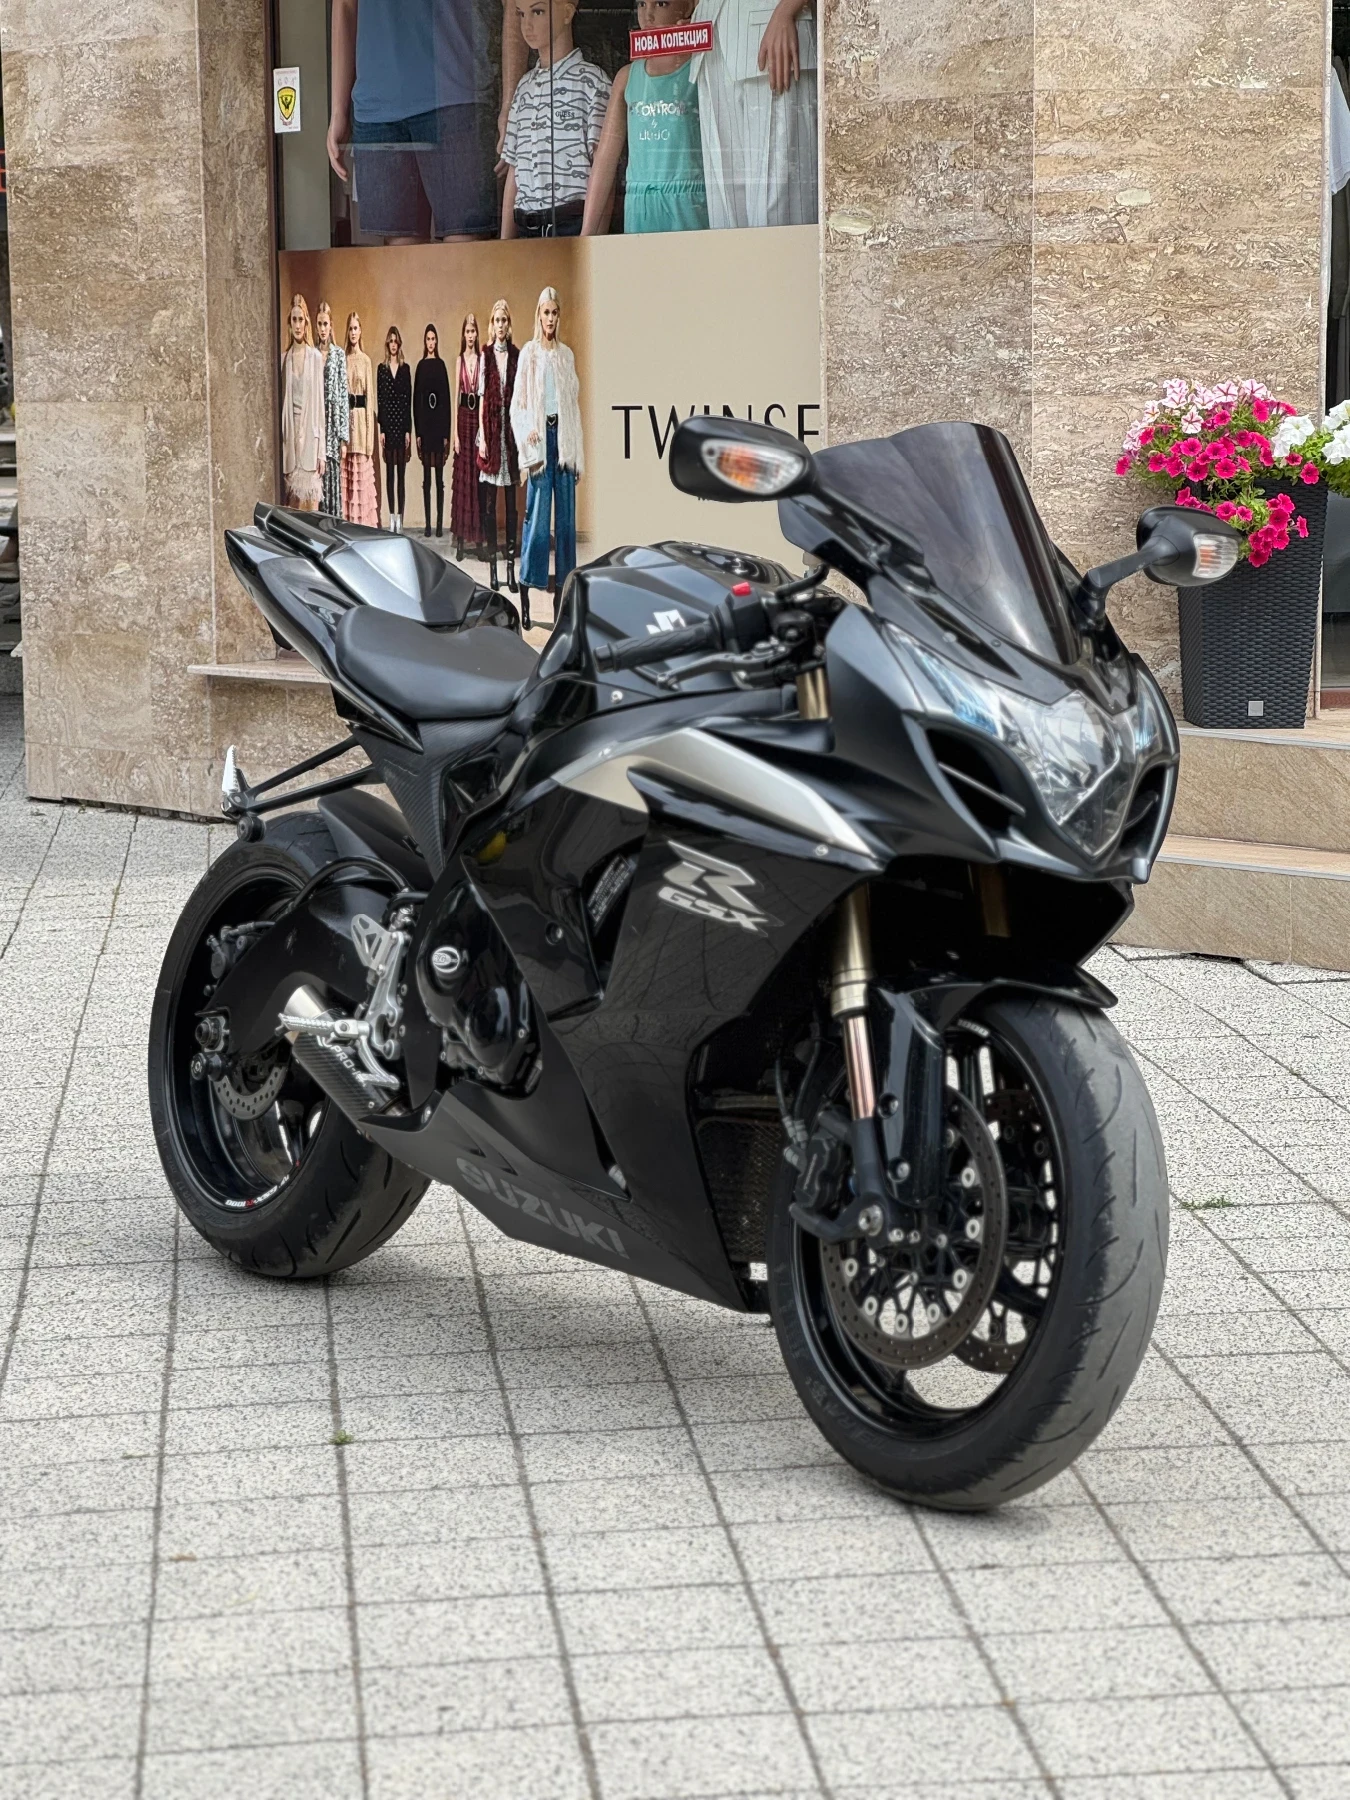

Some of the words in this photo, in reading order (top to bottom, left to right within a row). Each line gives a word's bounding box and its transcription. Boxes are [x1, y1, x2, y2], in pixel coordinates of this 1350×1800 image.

[634, 35, 660, 52] НОВА
[661, 28, 708, 48] КОЛЕКЦИЯ
[658, 886, 768, 931] GSX
[456, 1158, 630, 1259] SUZUKI
